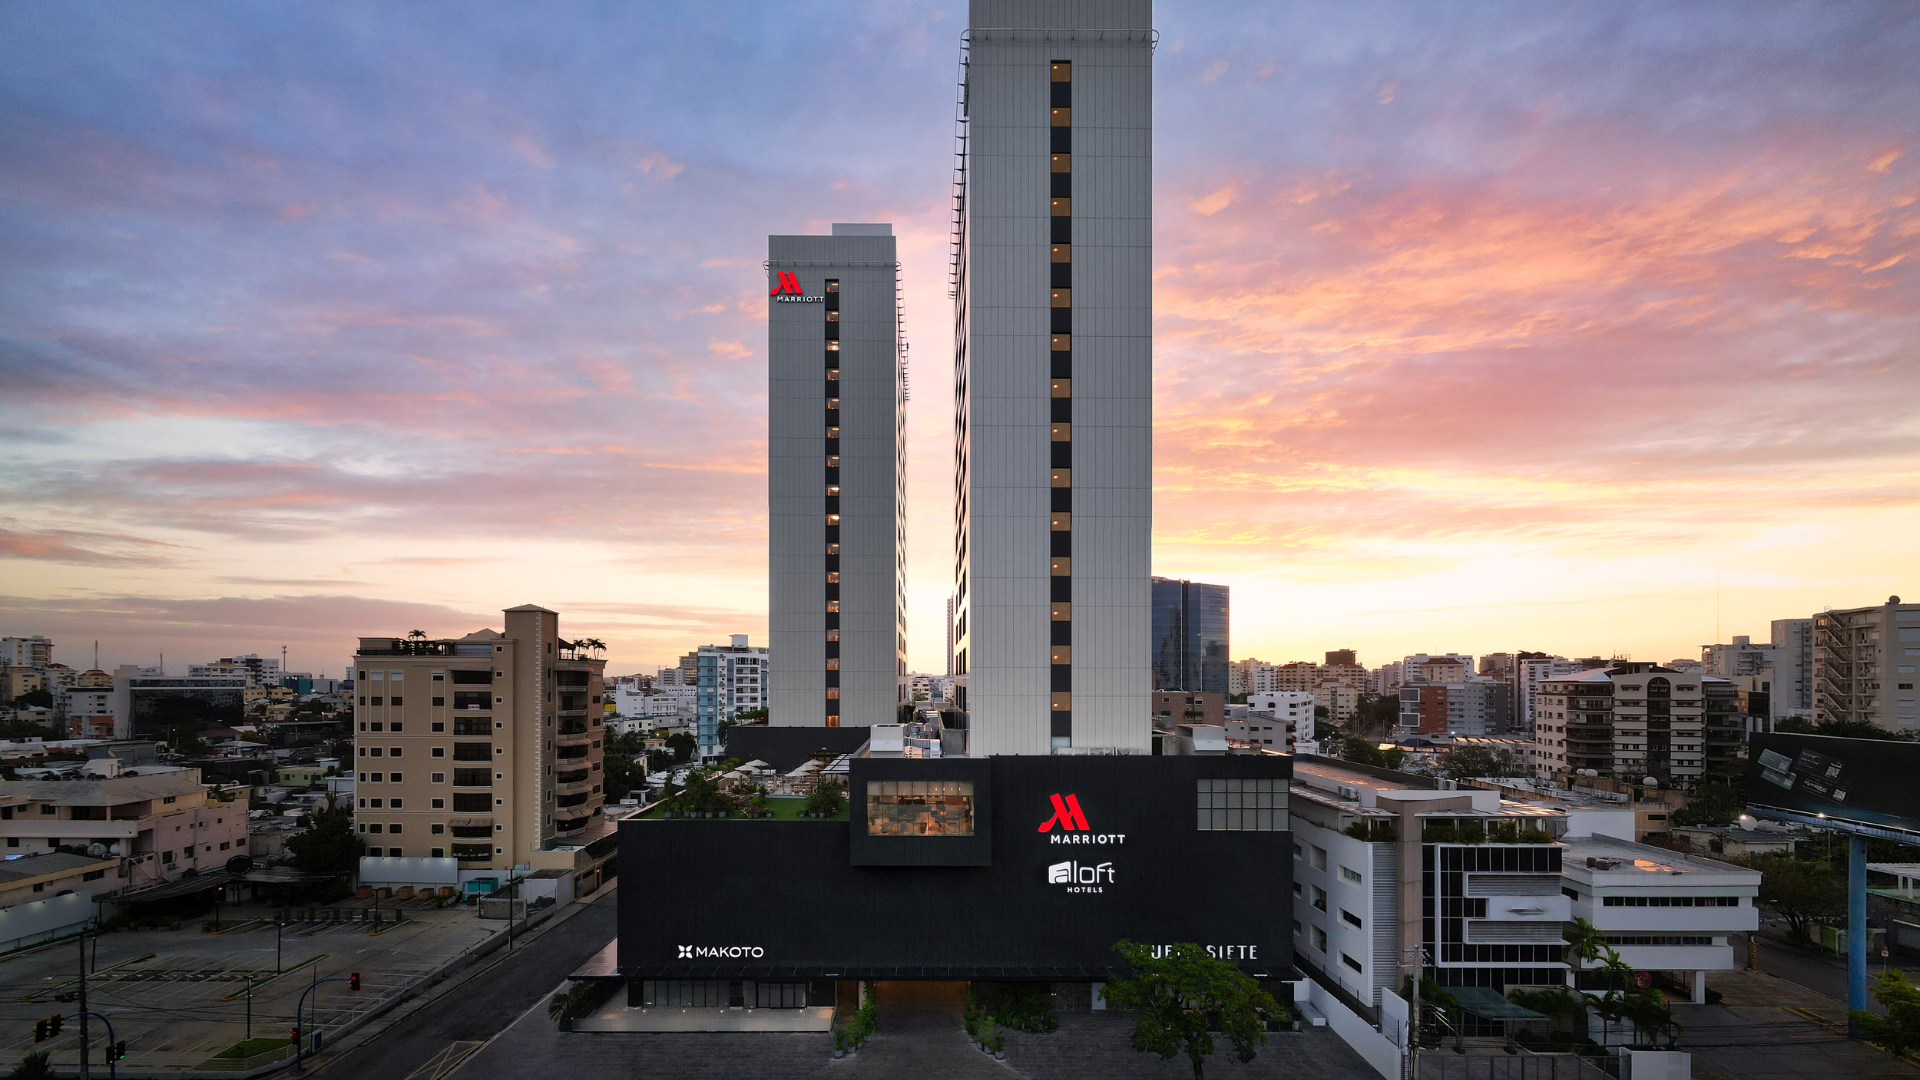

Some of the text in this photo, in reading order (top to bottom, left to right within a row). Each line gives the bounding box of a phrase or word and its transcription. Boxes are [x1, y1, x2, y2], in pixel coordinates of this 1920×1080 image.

[776, 295, 824, 303] MARRIOTT
[1050, 834, 1126, 845] MARRIOTT
[1048, 860, 1116, 884] aloft
[1066, 886, 1104, 894] HOTELS
[695, 946, 764, 958] MAKOTO
[1206, 944, 1258, 960] SIETE
